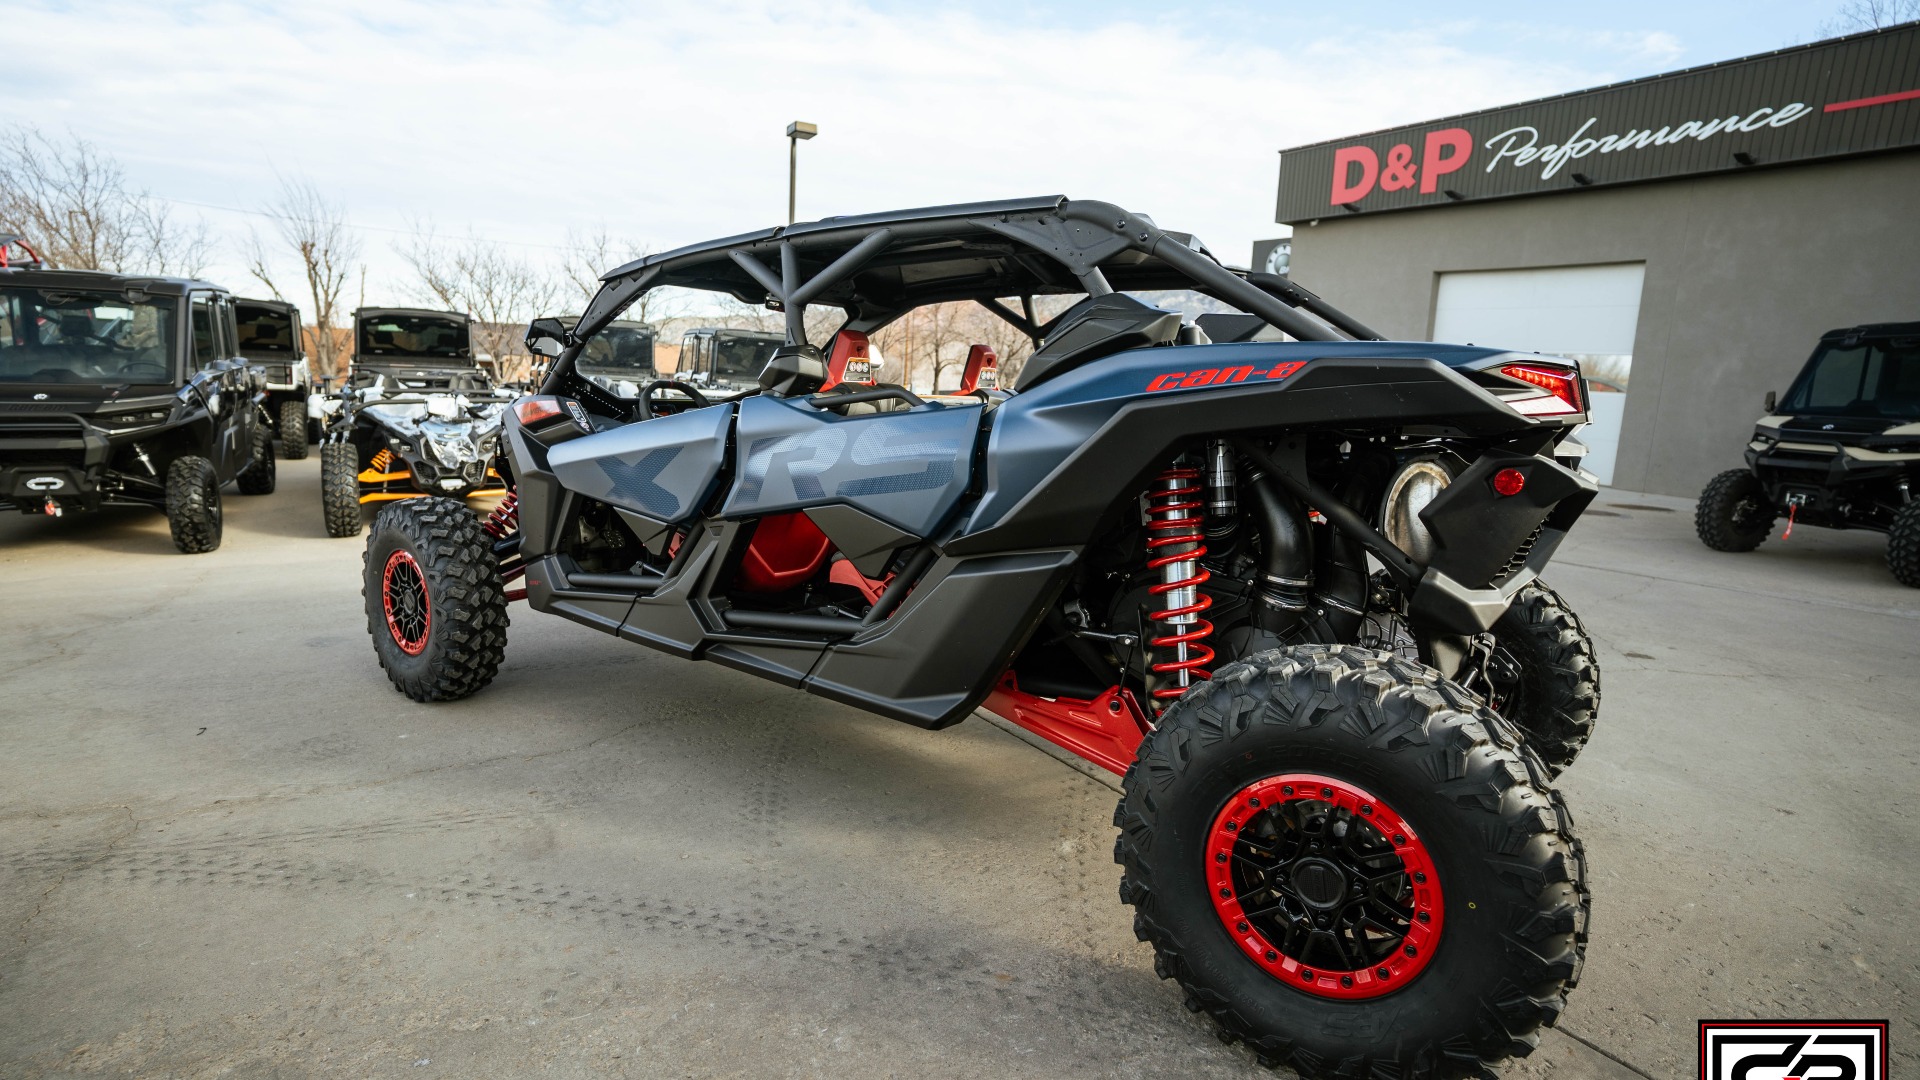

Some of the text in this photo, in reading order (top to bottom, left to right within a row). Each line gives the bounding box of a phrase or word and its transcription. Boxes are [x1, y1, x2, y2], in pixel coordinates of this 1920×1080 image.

[1331, 102, 1813, 205] D&P Performance
[595, 413, 969, 518] X RS
